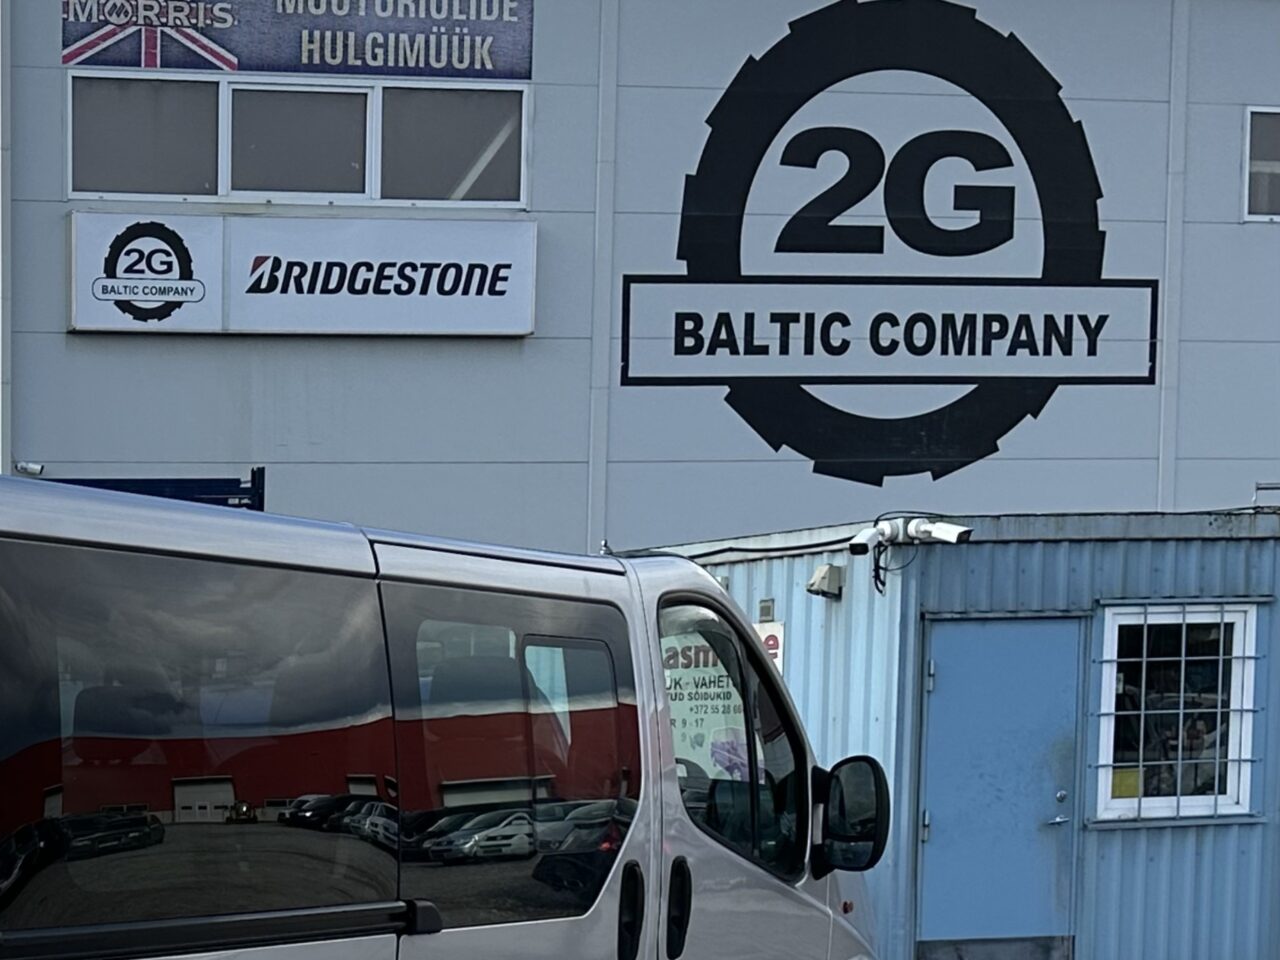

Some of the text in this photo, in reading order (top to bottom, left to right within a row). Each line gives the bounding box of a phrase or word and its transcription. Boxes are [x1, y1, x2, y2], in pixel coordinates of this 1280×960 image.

[70, 0, 234, 28] MORRIS
[301, 26, 494, 70] HULGIMÜÜK
[774, 126, 1015, 257] 2G
[123, 248, 173, 275] 2G
[245, 256, 512, 296] BRIDGESTONE
[101, 284, 195, 297] BALTIC COMPANY
[674, 312, 1109, 357] BALTIC COMPANY
